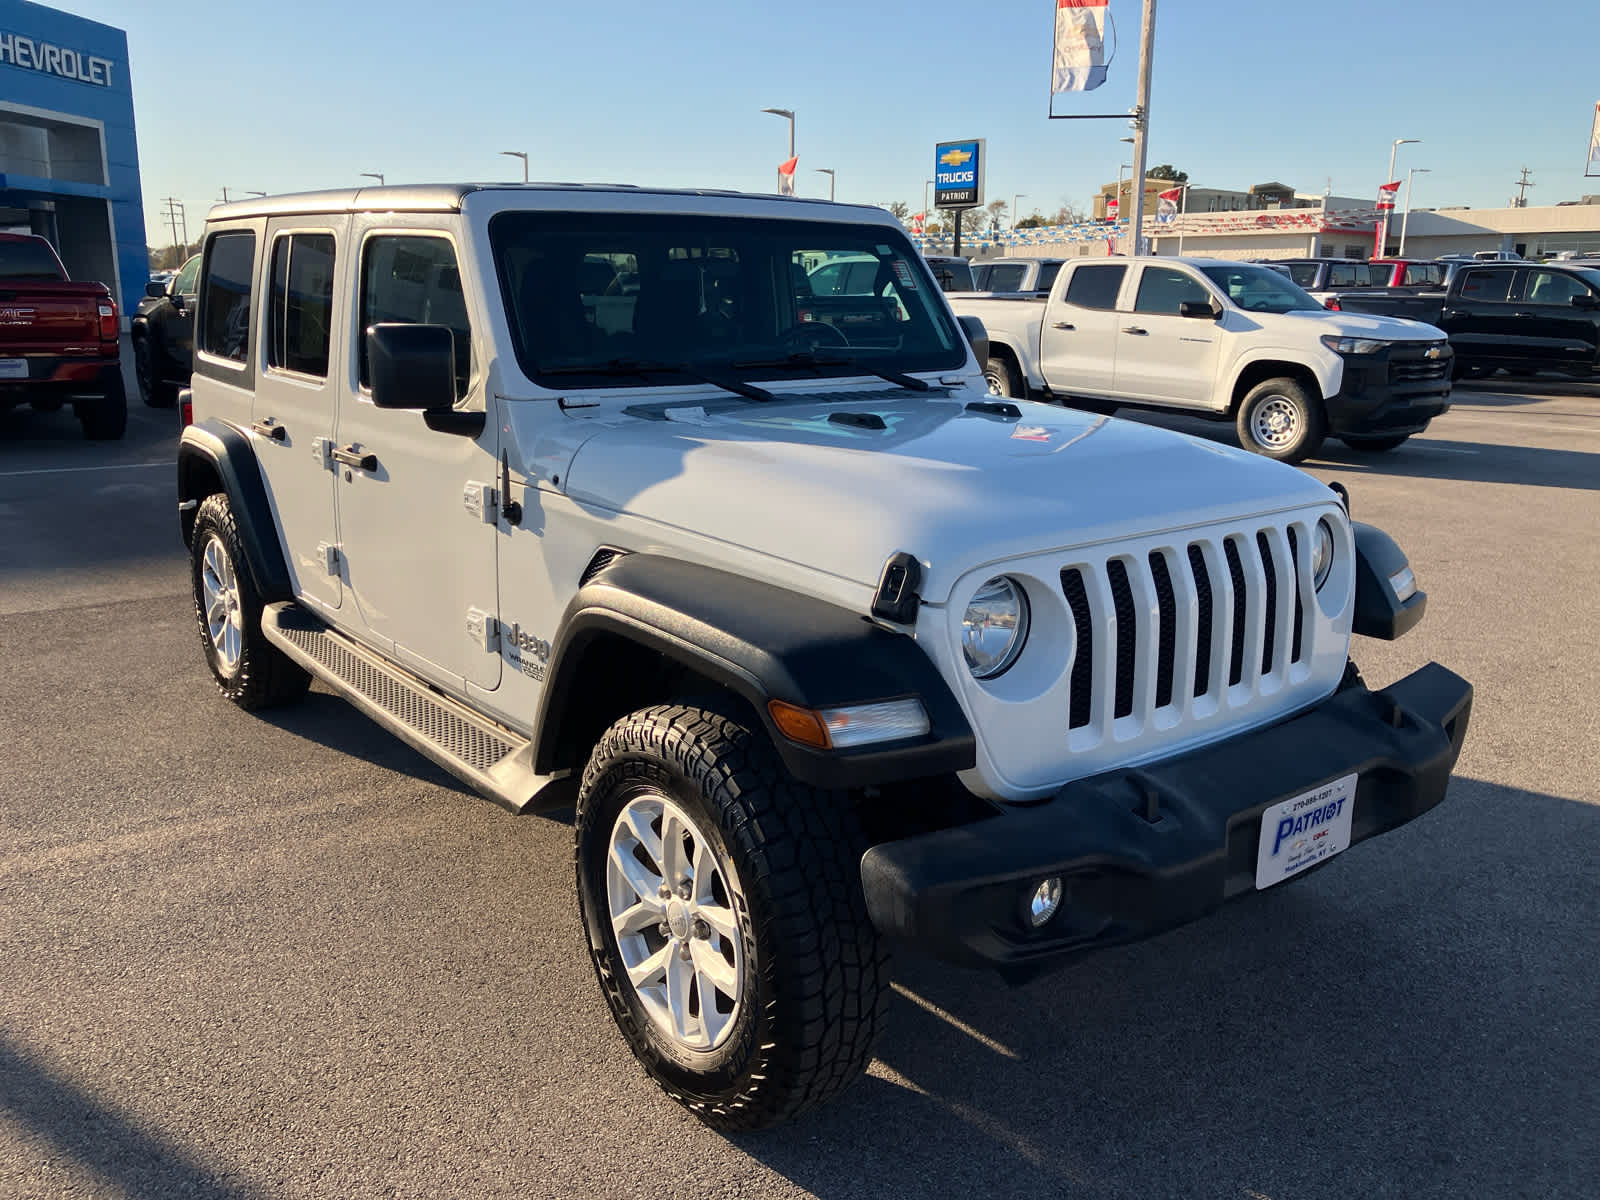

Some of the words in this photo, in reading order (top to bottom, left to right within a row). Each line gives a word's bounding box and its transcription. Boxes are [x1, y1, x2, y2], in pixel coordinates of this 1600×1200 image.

[0, 32, 113, 87] HEVROLET
[937, 171, 974, 184] TRUCKS
[941, 191, 969, 201] PATRIOT
[507, 621, 550, 664] Jeep
[1272, 797, 1346, 856] PATRIOT
